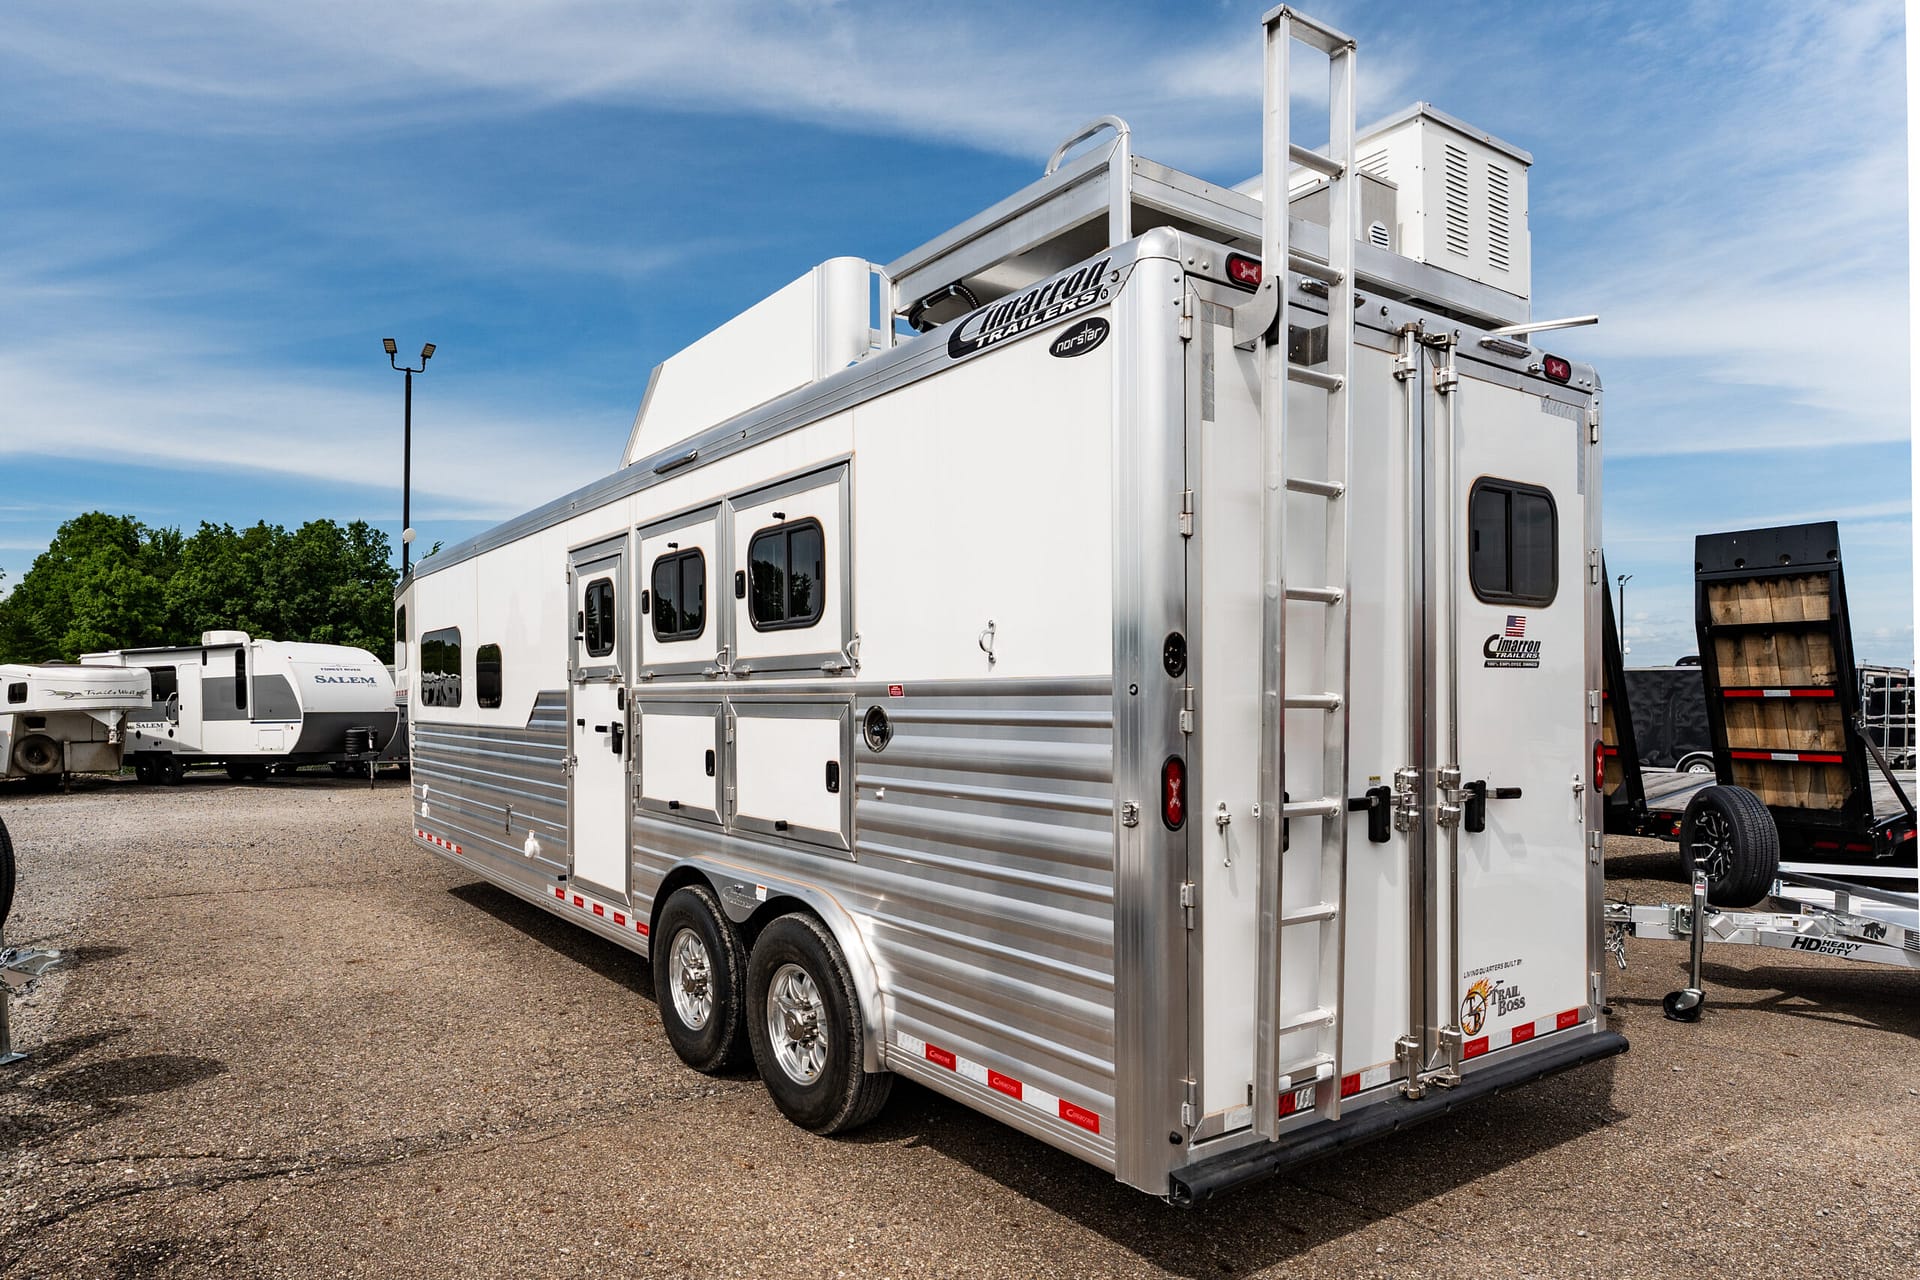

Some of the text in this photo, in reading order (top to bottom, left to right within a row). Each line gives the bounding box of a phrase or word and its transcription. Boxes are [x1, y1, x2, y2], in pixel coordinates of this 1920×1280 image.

[947, 256, 1111, 359] Cimarron
[975, 290, 1098, 348] TRAILERS
[1056, 324, 1104, 353] norstar
[1483, 634, 1541, 659] Cimarron
[314, 675, 377, 684] SALEM
[1791, 936, 1822, 951] HD
[1818, 946, 1852, 956] DUTY
[1821, 939, 1863, 951] HEAVY
[1497, 997, 1526, 1017] BOSS
